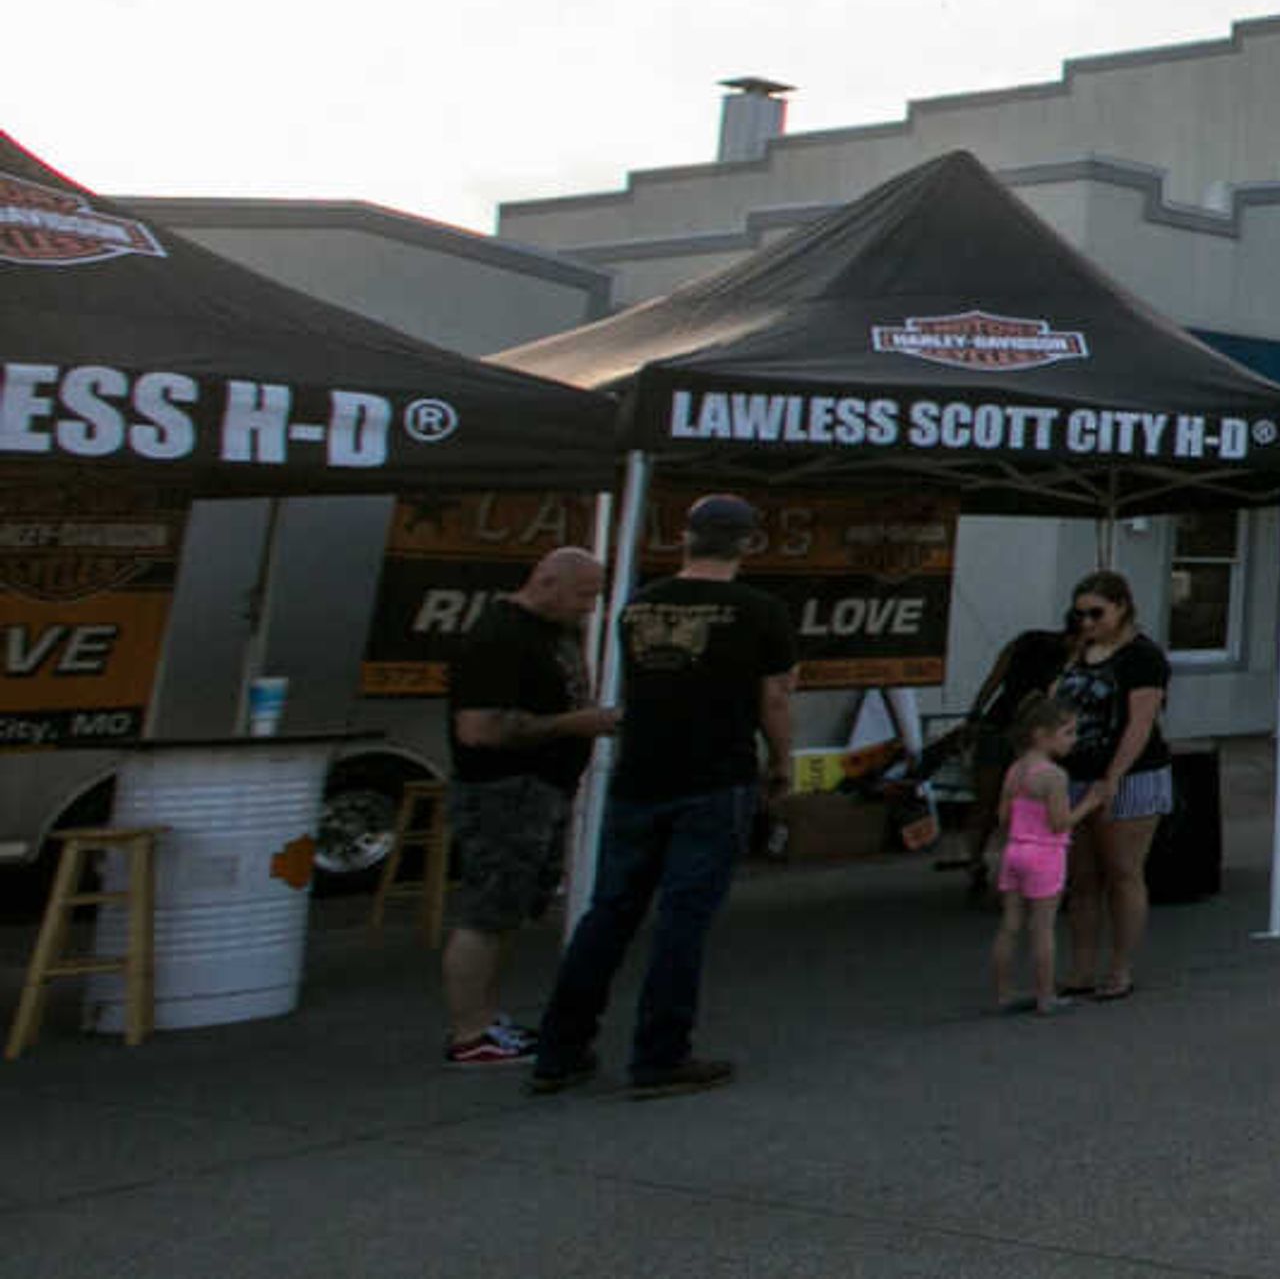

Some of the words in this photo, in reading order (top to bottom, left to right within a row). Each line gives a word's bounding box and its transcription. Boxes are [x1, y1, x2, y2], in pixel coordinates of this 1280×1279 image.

[671, 390, 899, 446] LAWLESS
[909, 401, 1058, 450] SCOTT
[1066, 408, 1169, 455] CITY
[801, 597, 926, 636] LOVE
